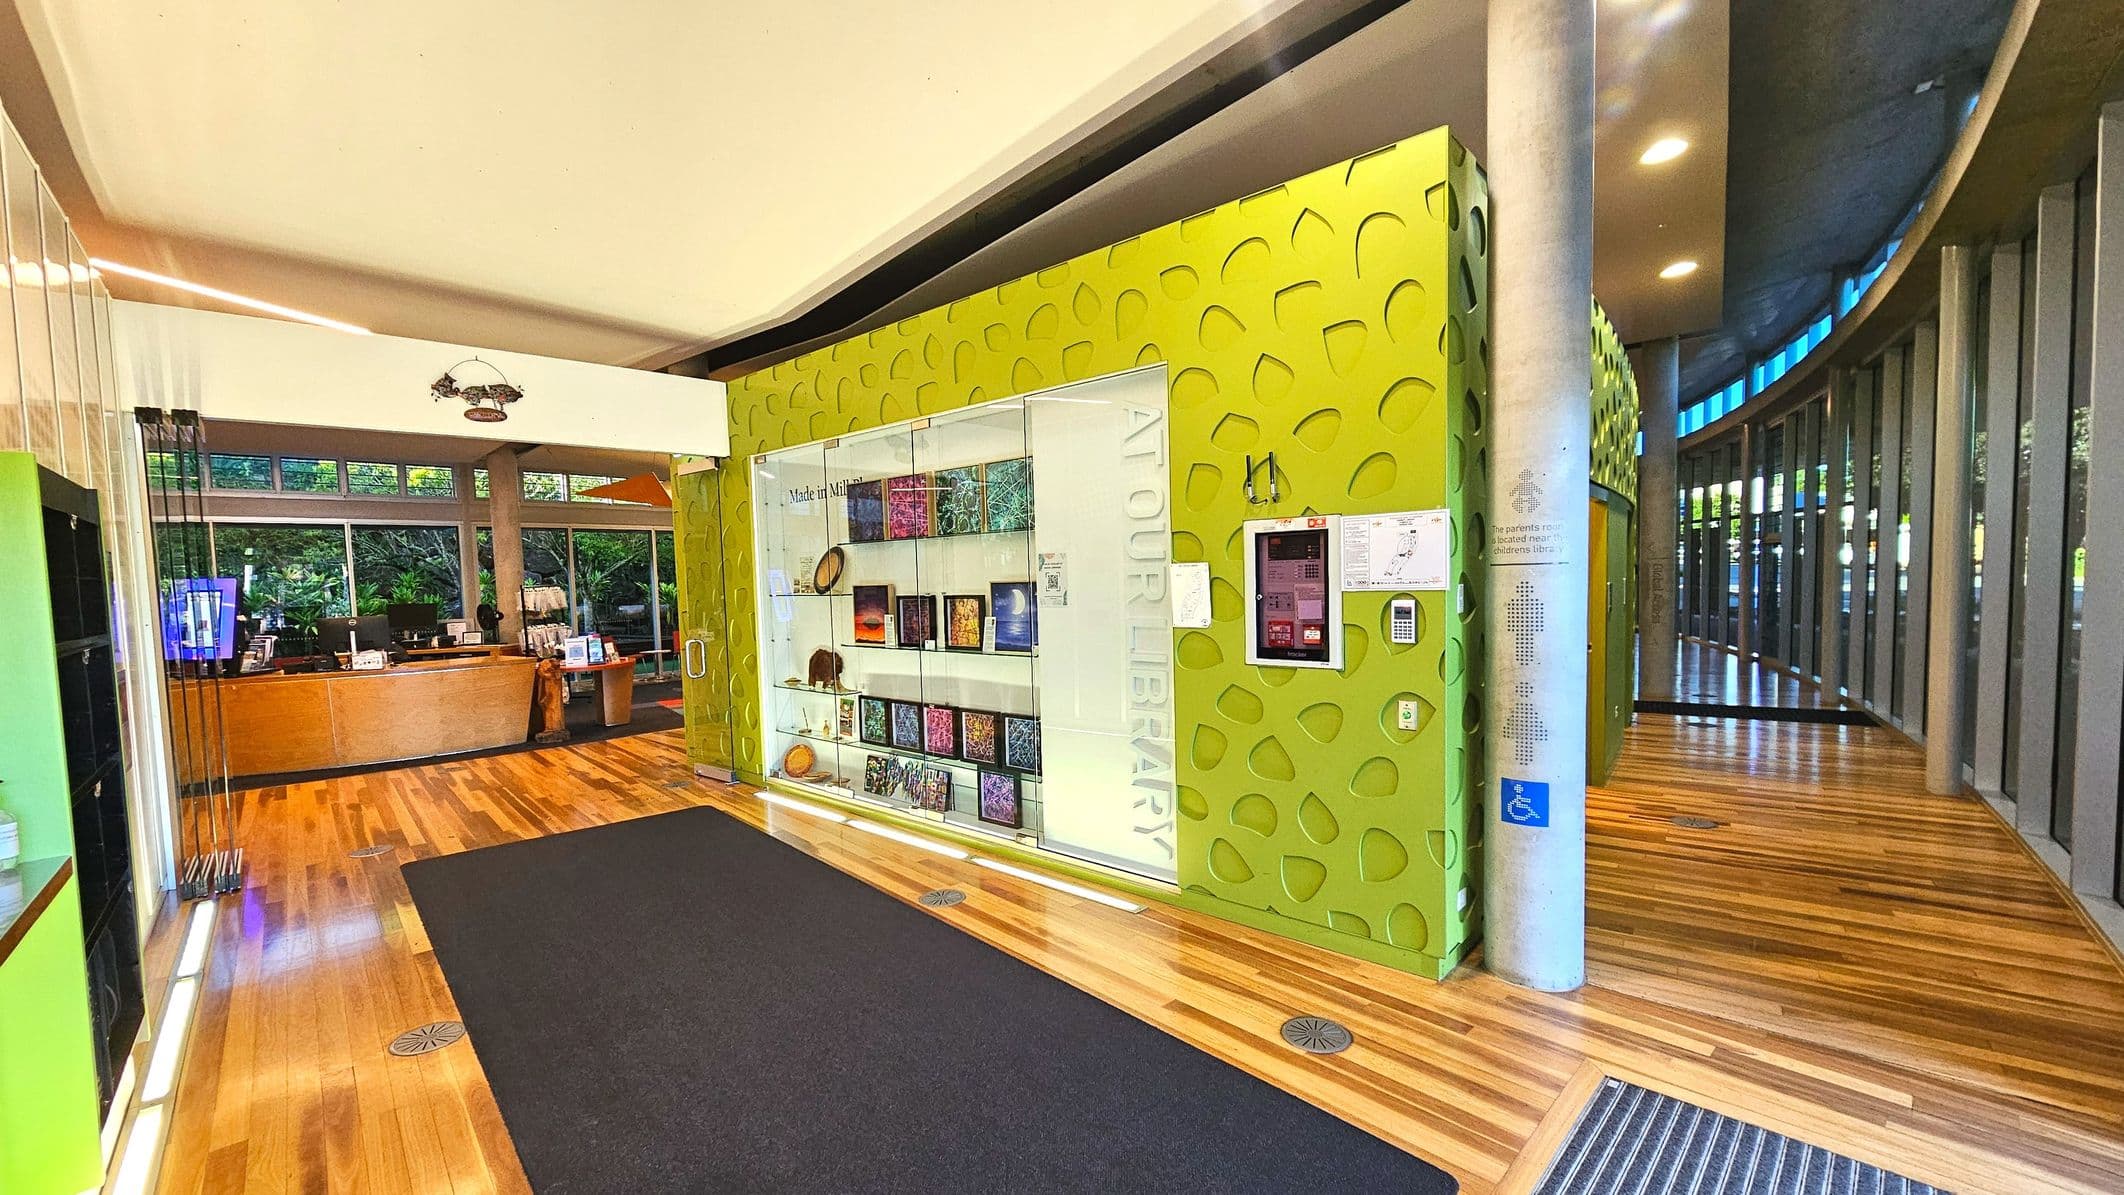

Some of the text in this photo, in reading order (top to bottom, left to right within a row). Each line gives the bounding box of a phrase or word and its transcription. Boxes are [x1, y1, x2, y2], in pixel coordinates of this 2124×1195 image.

[789, 485, 815, 504] Made
[817, 484, 827, 500] in
[1505, 523, 1540, 535] parents
[1497, 534, 1527, 545] located
[1529, 534, 1551, 543] near
[1493, 543, 1564, 555] childrens libray
[1122, 406, 1174, 861] AT OUR LIBRARY
